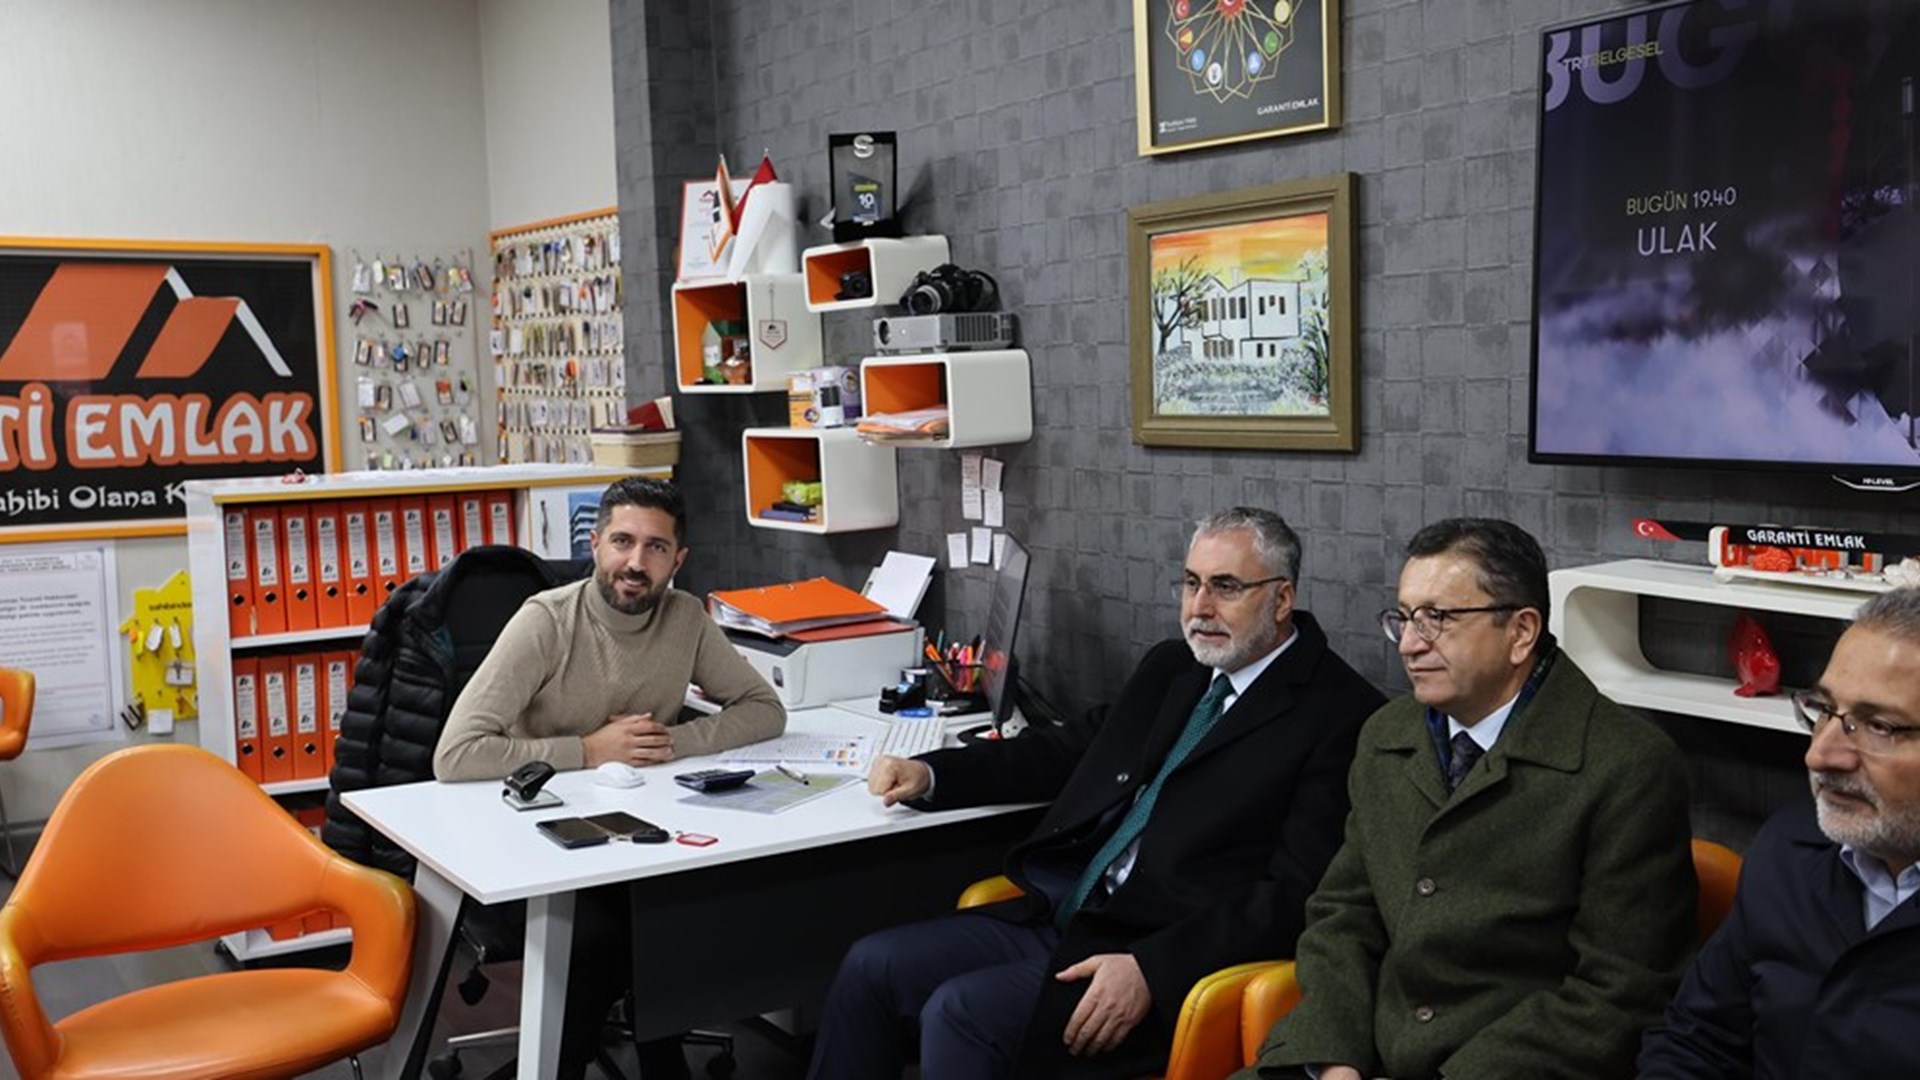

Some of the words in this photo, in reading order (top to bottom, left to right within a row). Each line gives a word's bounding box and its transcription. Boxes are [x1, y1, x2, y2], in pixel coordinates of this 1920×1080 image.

[1626, 190, 1688, 215] BUGÜN
[1693, 186, 1737, 209] 19.40
[1638, 221, 1718, 256] ULAK
[76, 400, 309, 460] EMLAK
[69, 485, 157, 509] Olana
[1746, 529, 1811, 545] GARANTİ
[1815, 533, 1866, 549] EMLAK
